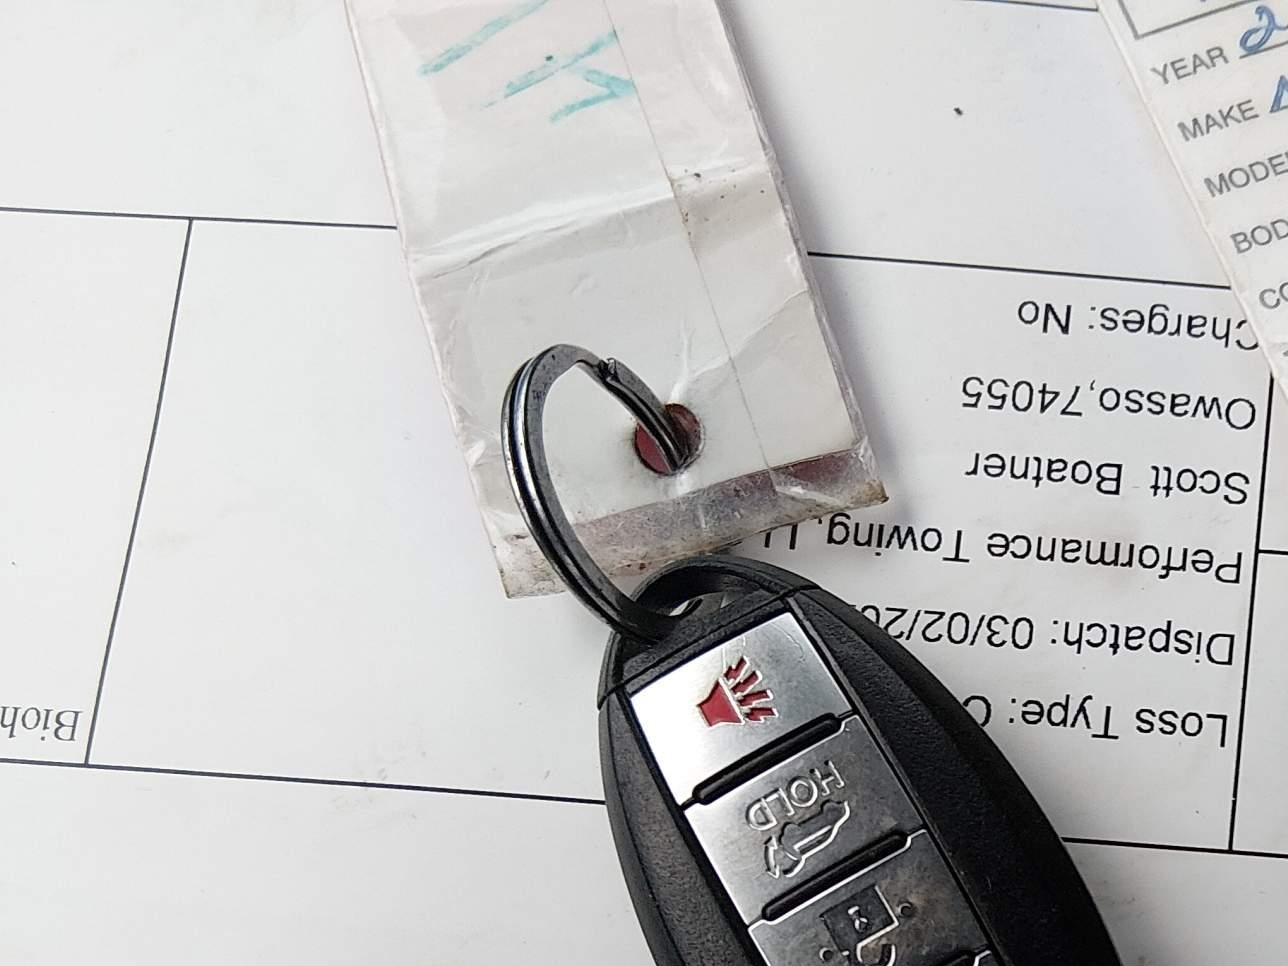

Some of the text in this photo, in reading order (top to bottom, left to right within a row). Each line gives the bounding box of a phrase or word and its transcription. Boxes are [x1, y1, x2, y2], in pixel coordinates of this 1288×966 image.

[1150, 46, 1229, 86] YEAR
[1177, 100, 1260, 142] MAKE
[1016, 299, 1073, 335] No
[960, 375, 1258, 430] Owasso,74055
[964, 452, 1251, 505] Scott Boatner
[987, 531, 1244, 584] Performance
[1050, 618, 1236, 666] Dispatch:
[0, 706, 83, 742] Bioh
[1008, 693, 1120, 740] Type:
[1135, 706, 1229, 748] Loss
[746, 760, 845, 831] HOLD
